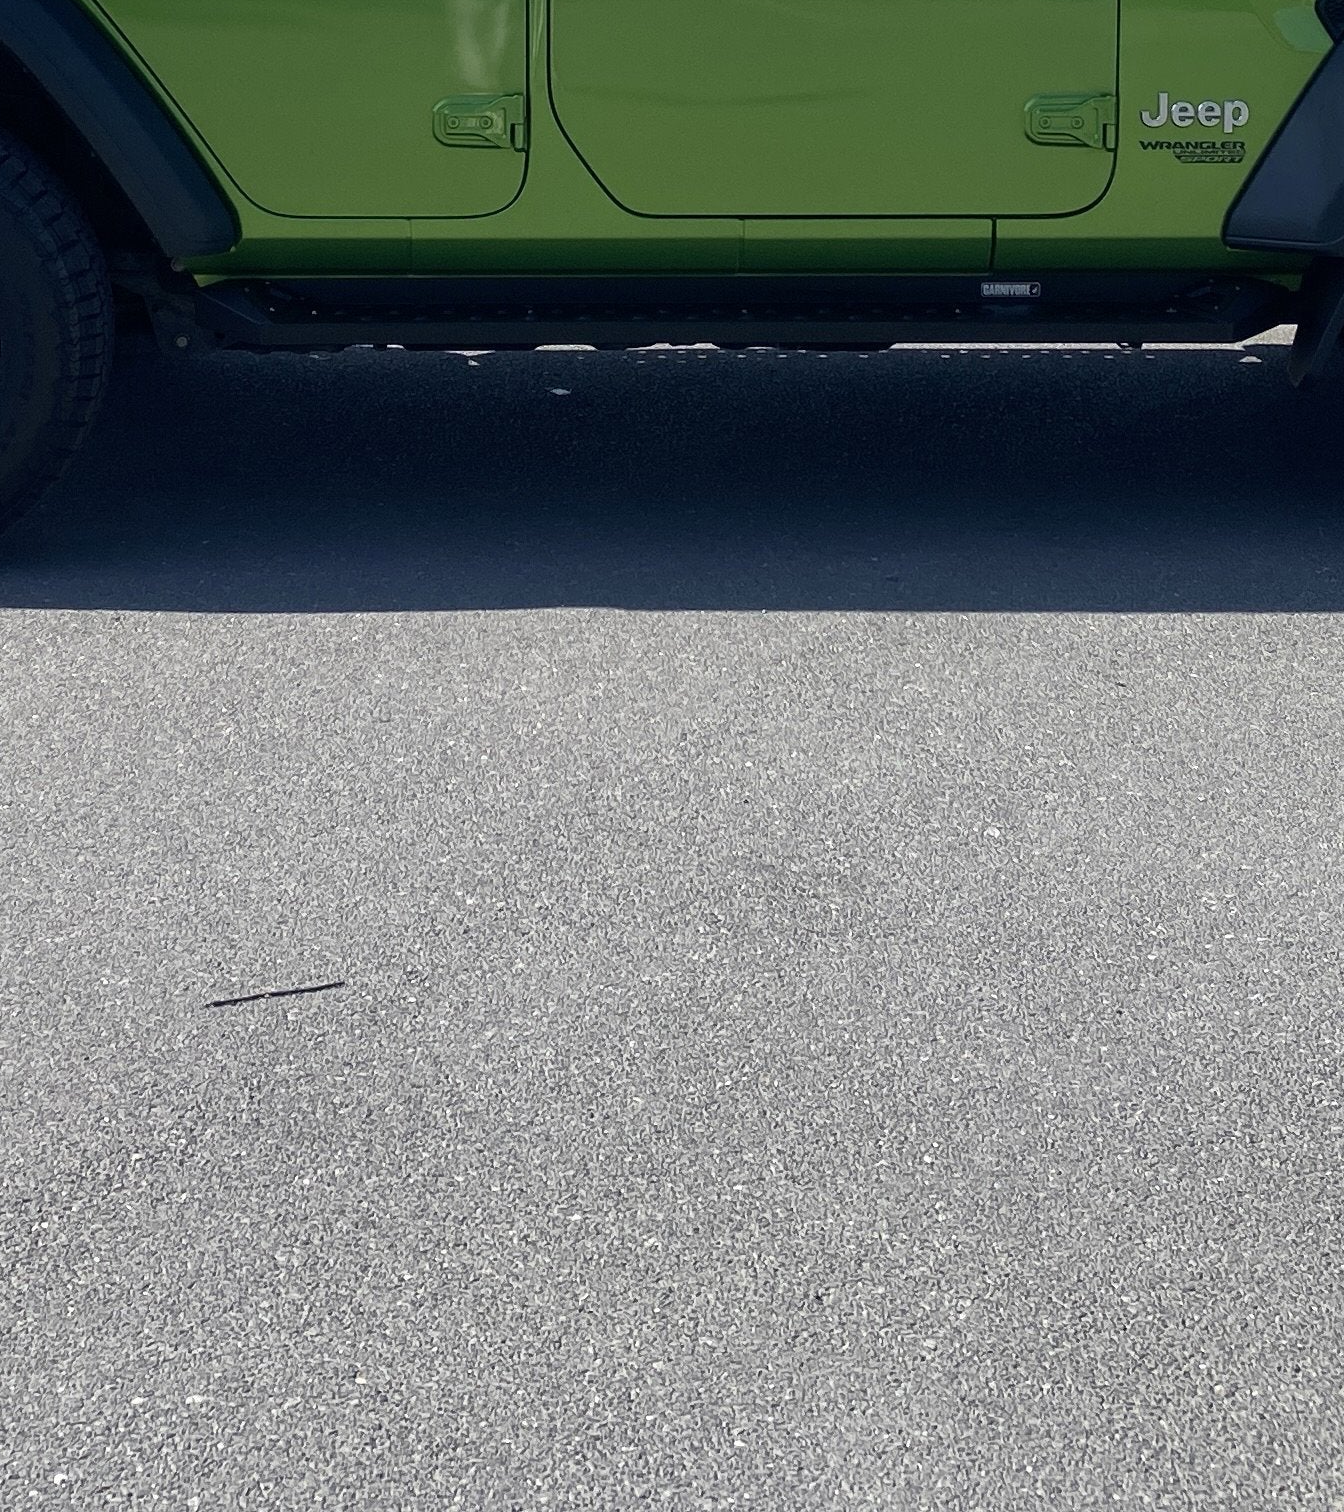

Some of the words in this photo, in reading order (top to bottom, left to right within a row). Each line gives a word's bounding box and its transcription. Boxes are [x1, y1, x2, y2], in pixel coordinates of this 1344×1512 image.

[1140, 92, 1250, 134] Jeep
[1139, 140, 1246, 150] WRANGLER
[983, 284, 1031, 296] CARNIVORE
